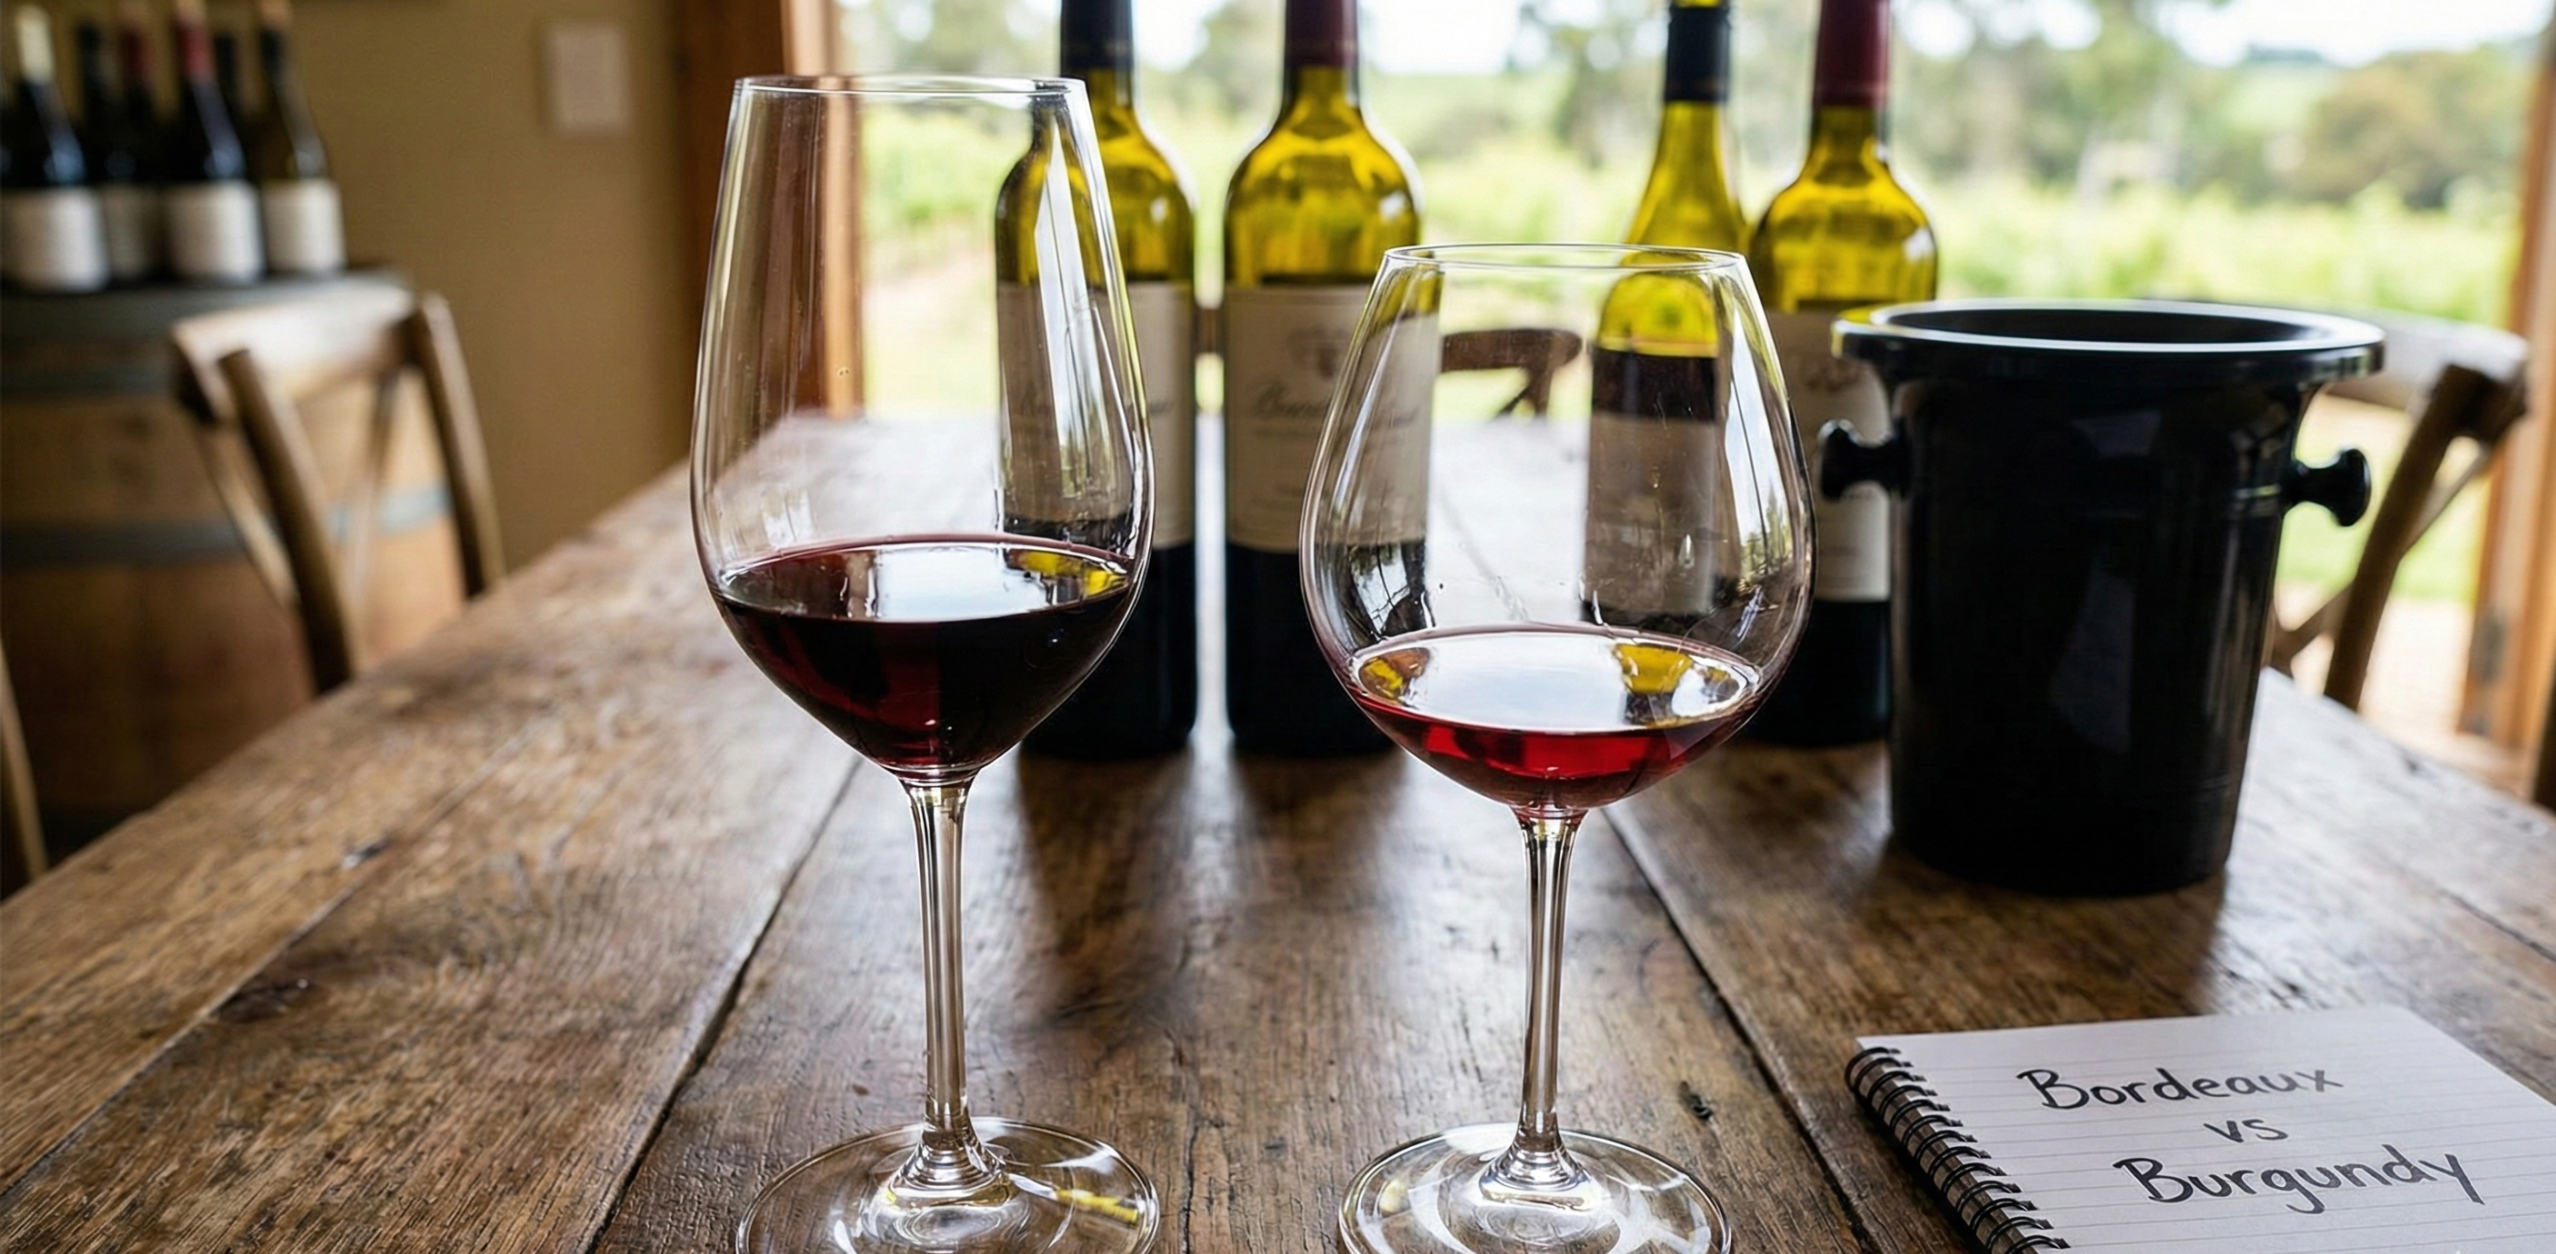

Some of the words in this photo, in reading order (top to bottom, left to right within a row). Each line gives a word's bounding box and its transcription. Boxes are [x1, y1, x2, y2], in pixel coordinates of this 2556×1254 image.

[2016, 1067, 2344, 1110] Bordeaux
[2203, 1117, 2289, 1144] vs
[2112, 1143, 2486, 1214] Burgundy
